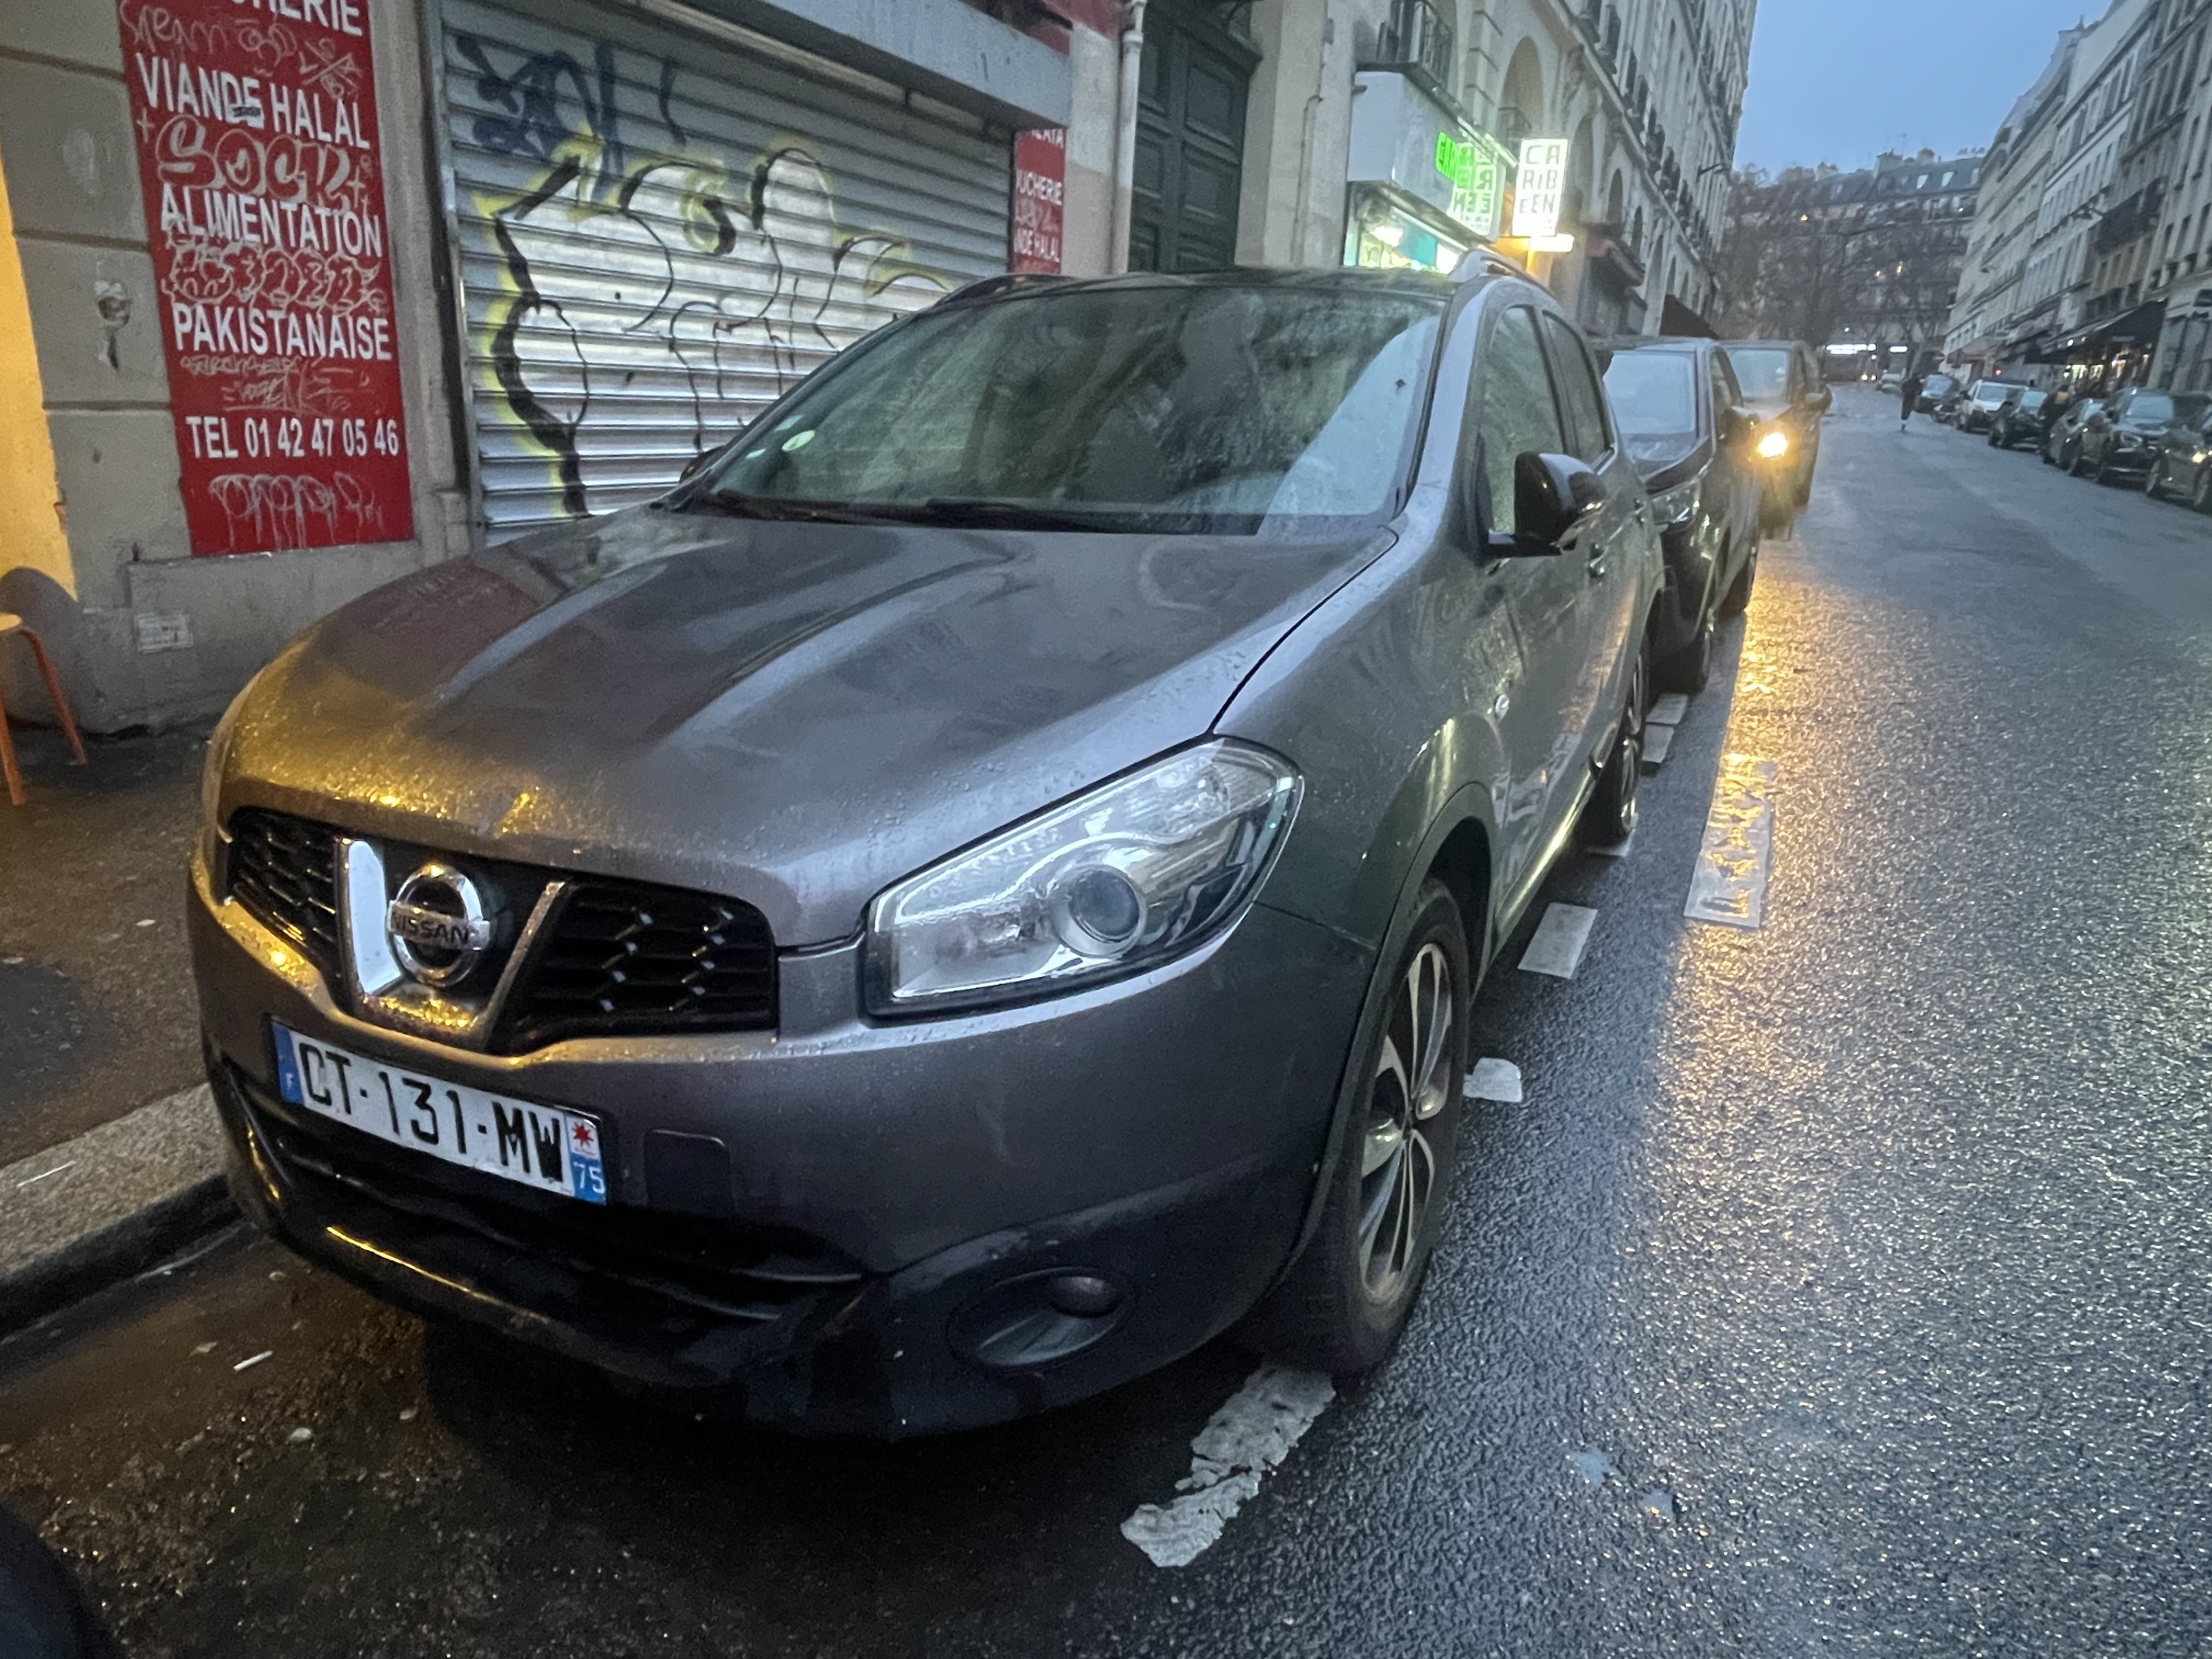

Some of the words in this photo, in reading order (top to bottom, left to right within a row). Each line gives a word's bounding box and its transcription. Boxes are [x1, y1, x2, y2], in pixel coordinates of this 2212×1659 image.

[136, 53, 264, 129] VIANDE
[269, 83, 370, 149] HALAL
[161, 183, 382, 257] ALIMENTATION
[172, 303, 392, 362] PAKISTANAISE
[186, 416, 238, 458] TEL
[245, 418, 271, 458] 01
[278, 417, 304, 458] 42
[311, 419, 334, 456] 47
[342, 419, 367, 456] 05
[374, 419, 399, 456] 46
[393, 912, 469, 945] NISSAN
[573, 1161, 605, 1194] 75
